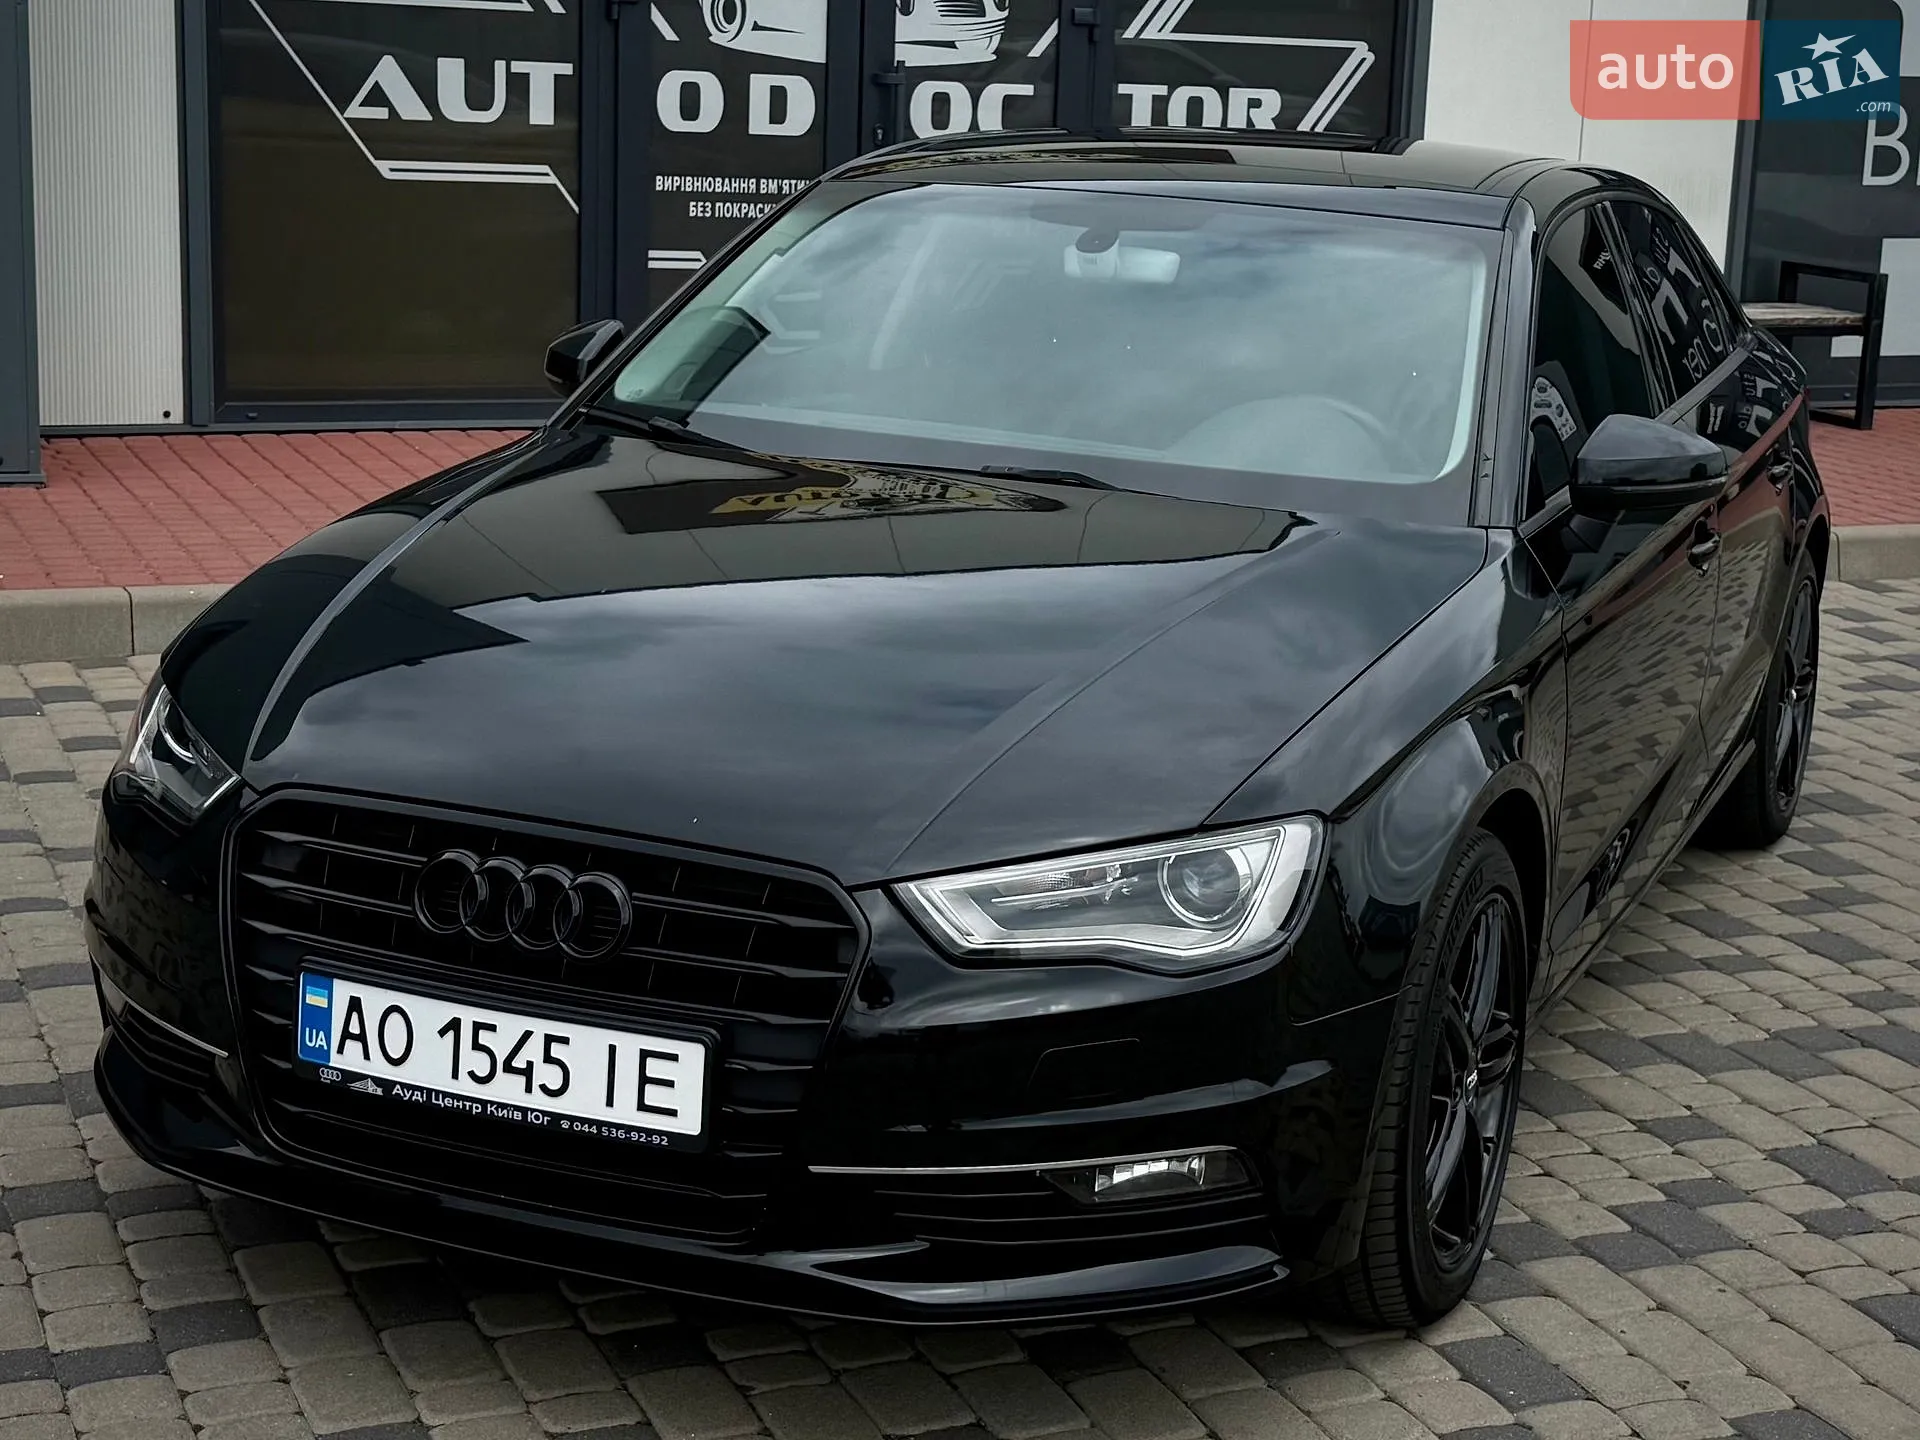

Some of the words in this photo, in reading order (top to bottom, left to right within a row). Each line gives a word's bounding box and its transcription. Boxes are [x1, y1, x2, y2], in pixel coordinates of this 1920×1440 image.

[343, 54, 574, 126] AUT
[655, 175, 757, 194] ВИРІВНЮВАННЯ
[759, 177, 810, 195] ВМ'ЯТИ
[688, 201, 712, 218] БЕЗ
[715, 202, 777, 219] ПОКРАСК
[305, 1027, 328, 1051] UA
[336, 994, 414, 1067] AO
[437, 1015, 571, 1098] 1545
[605, 1042, 681, 1118] IE
[391, 1084, 427, 1103] Ауді
[431, 1091, 482, 1115] Центр
[487, 1103, 522, 1120] Київ
[527, 1110, 551, 1126] Юг
[573, 1121, 598, 1134] 044
[601, 1126, 669, 1146] 536-92-92
